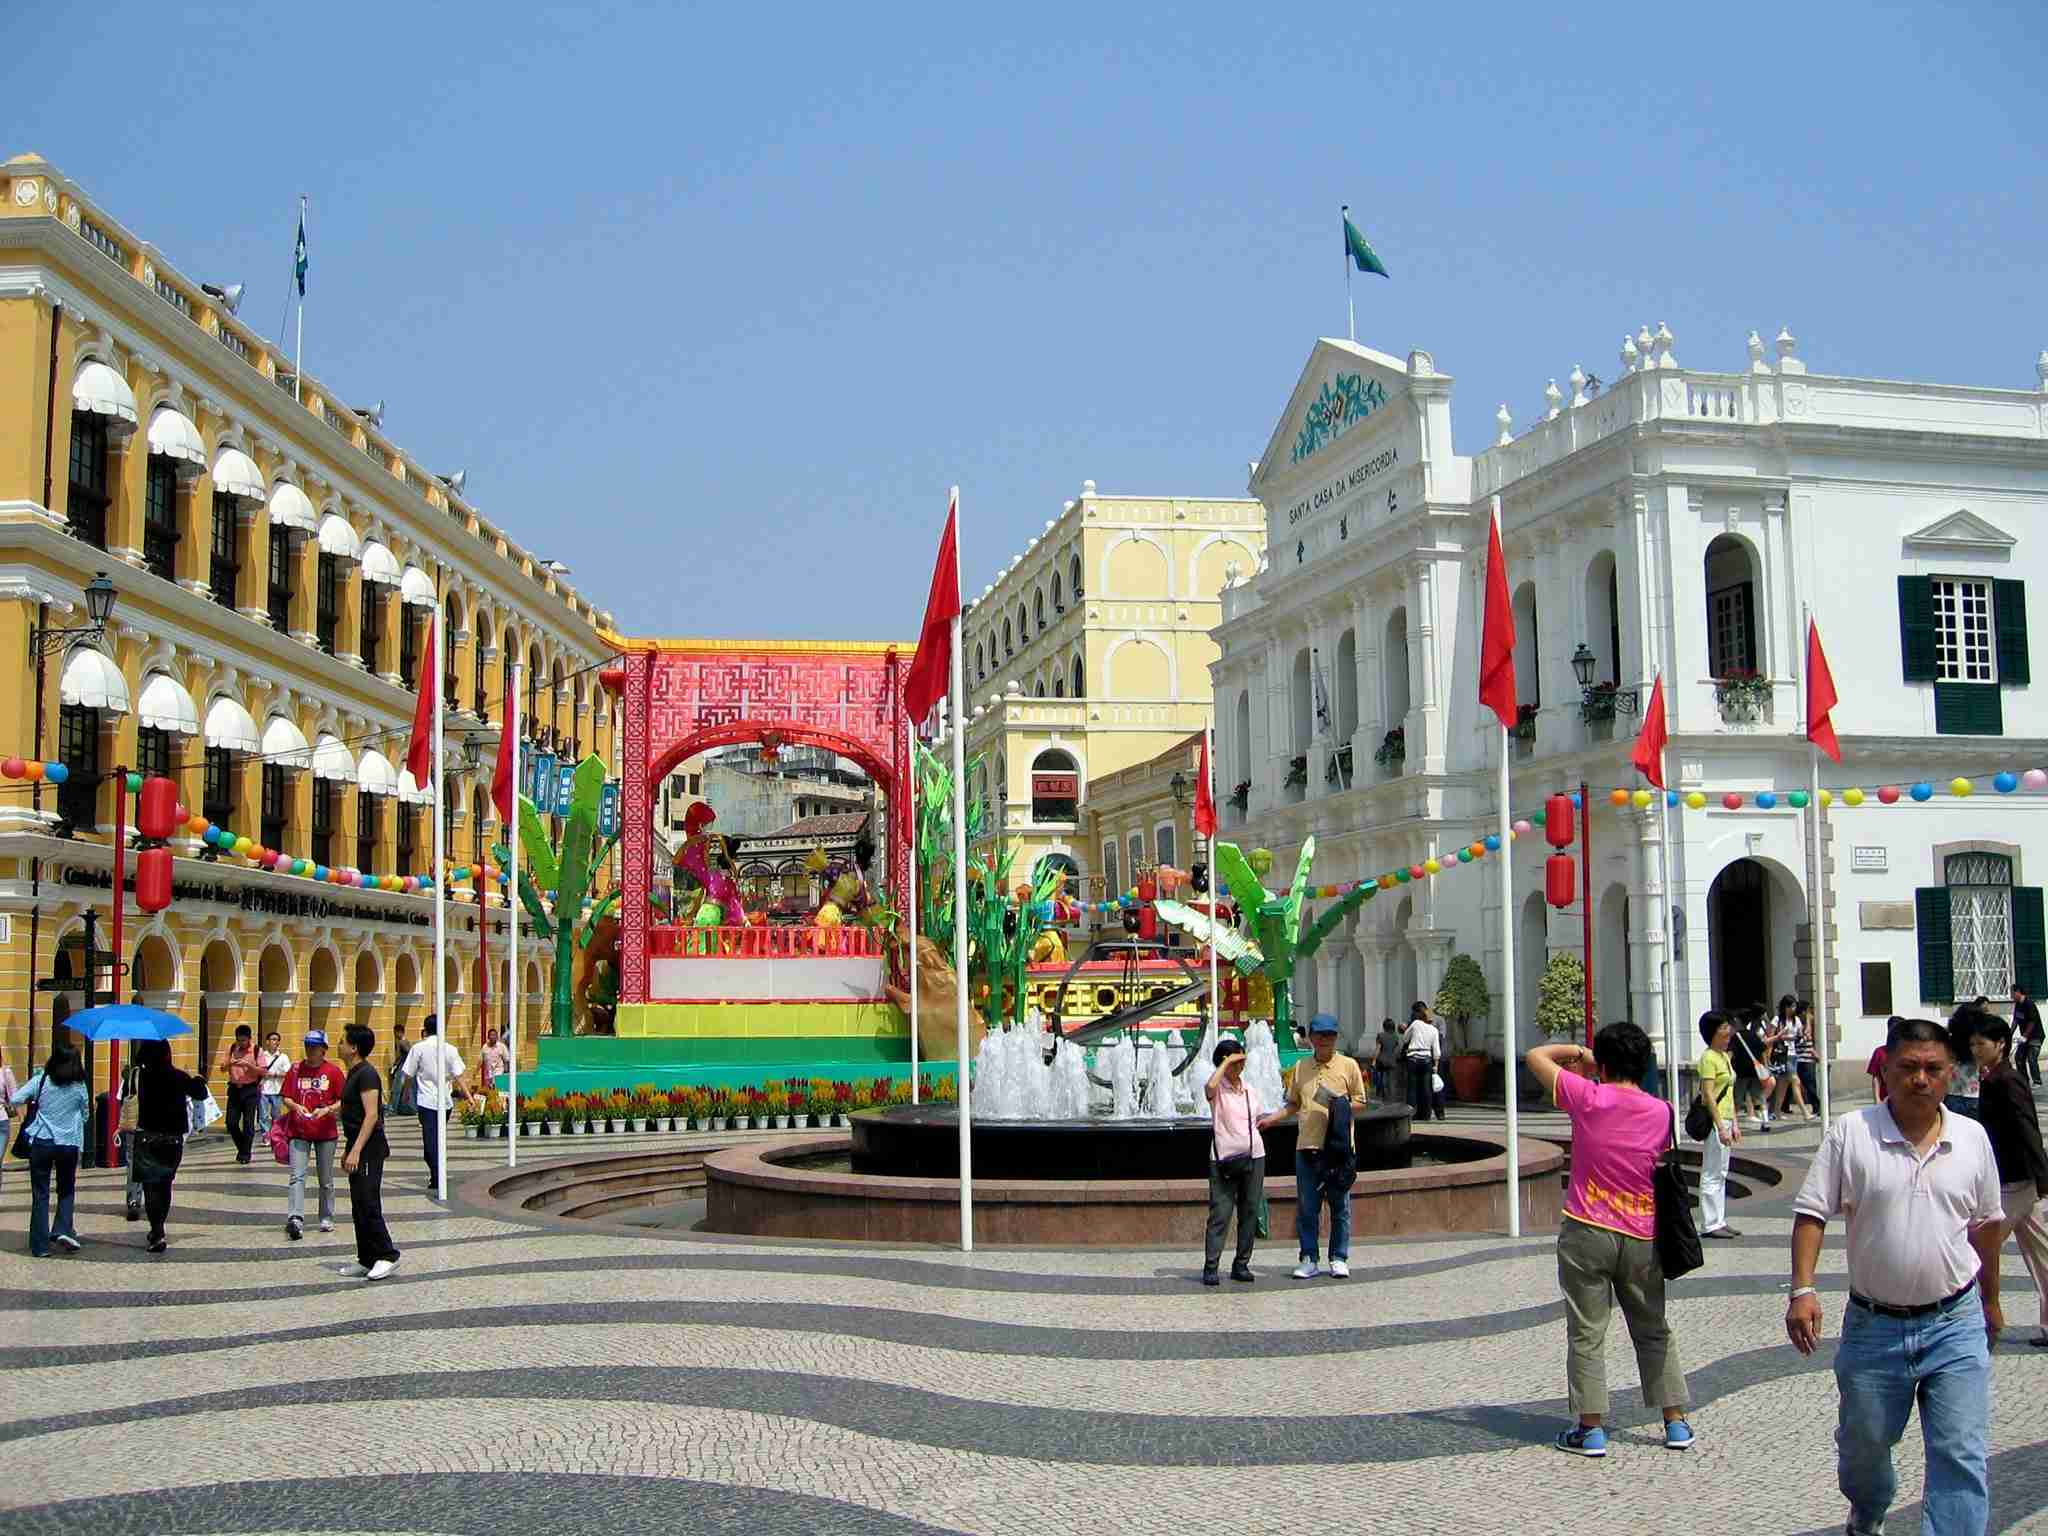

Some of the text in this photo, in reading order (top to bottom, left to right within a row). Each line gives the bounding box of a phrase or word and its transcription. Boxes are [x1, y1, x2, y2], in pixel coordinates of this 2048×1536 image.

[1288, 448, 1399, 525] SANTA CASA DA MISERICORDIA
